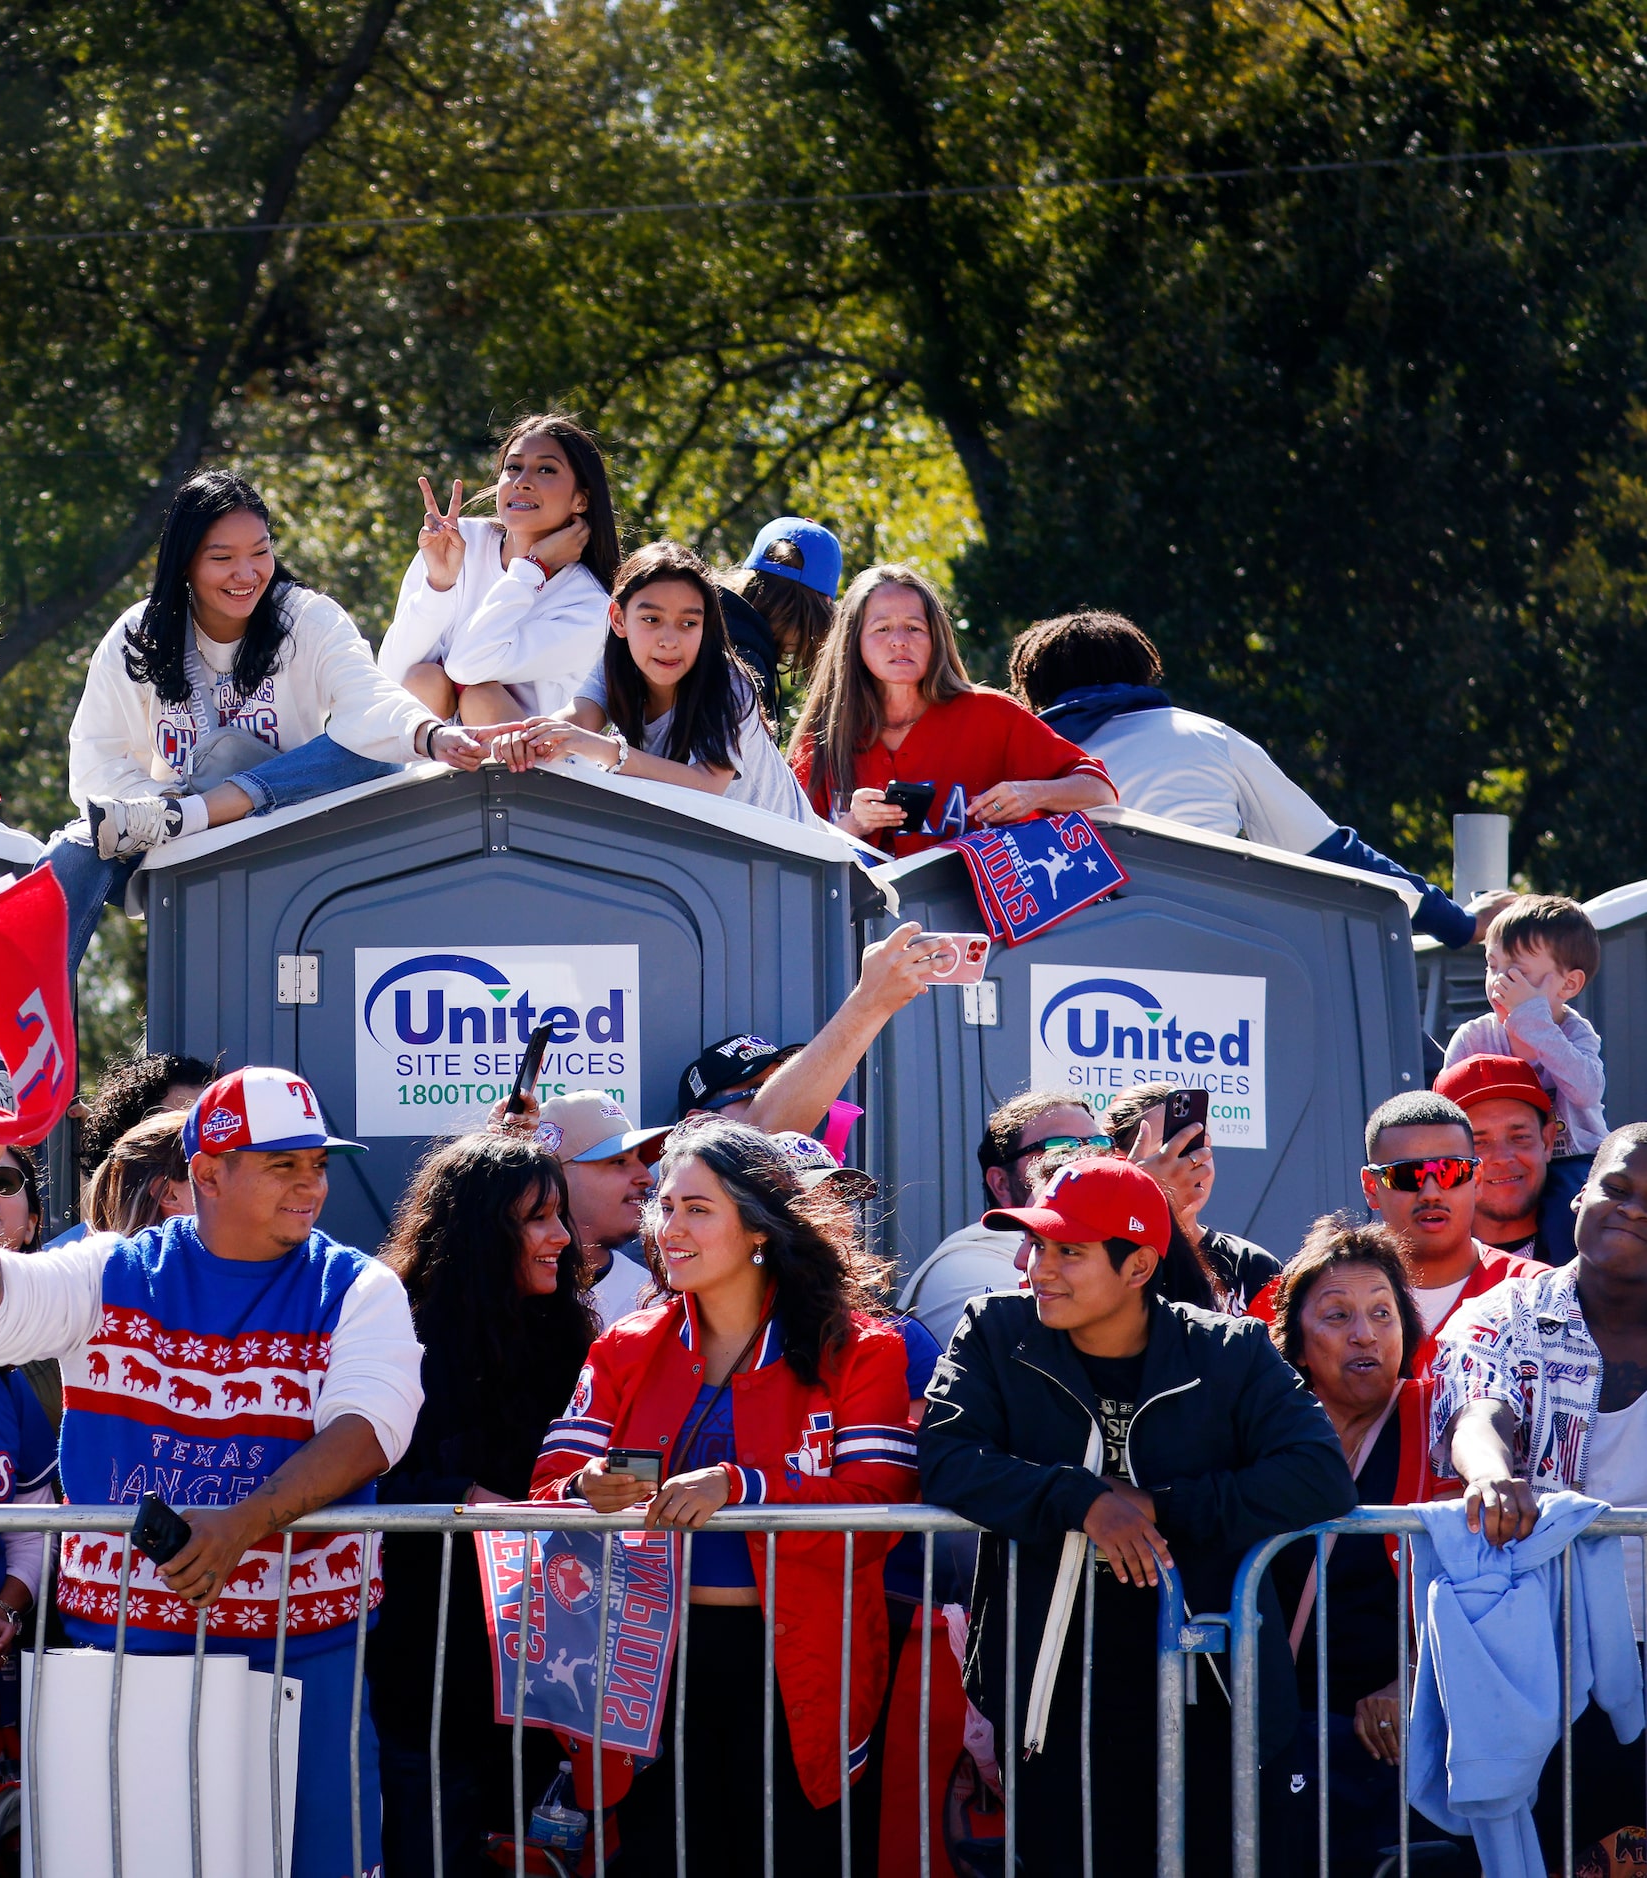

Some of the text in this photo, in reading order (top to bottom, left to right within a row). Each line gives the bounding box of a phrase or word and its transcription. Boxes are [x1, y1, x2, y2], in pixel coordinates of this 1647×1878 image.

[1002, 831, 1034, 888] WORLD
[394, 989, 625, 1045] United
[16, 986, 64, 1116] T
[1067, 1008, 1250, 1067] United
[396, 1054, 462, 1077] SITE
[1068, 1066, 1123, 1087] SITE
[286, 1081, 317, 1120] T
[1218, 1123, 1250, 1135] 41759
[1045, 1165, 1083, 1200] T
[1544, 1360, 1587, 1385] ngers
[151, 1433, 266, 1470] TEXAS
[808, 1429, 834, 1470] T
[109, 1457, 273, 1506] ANGE
